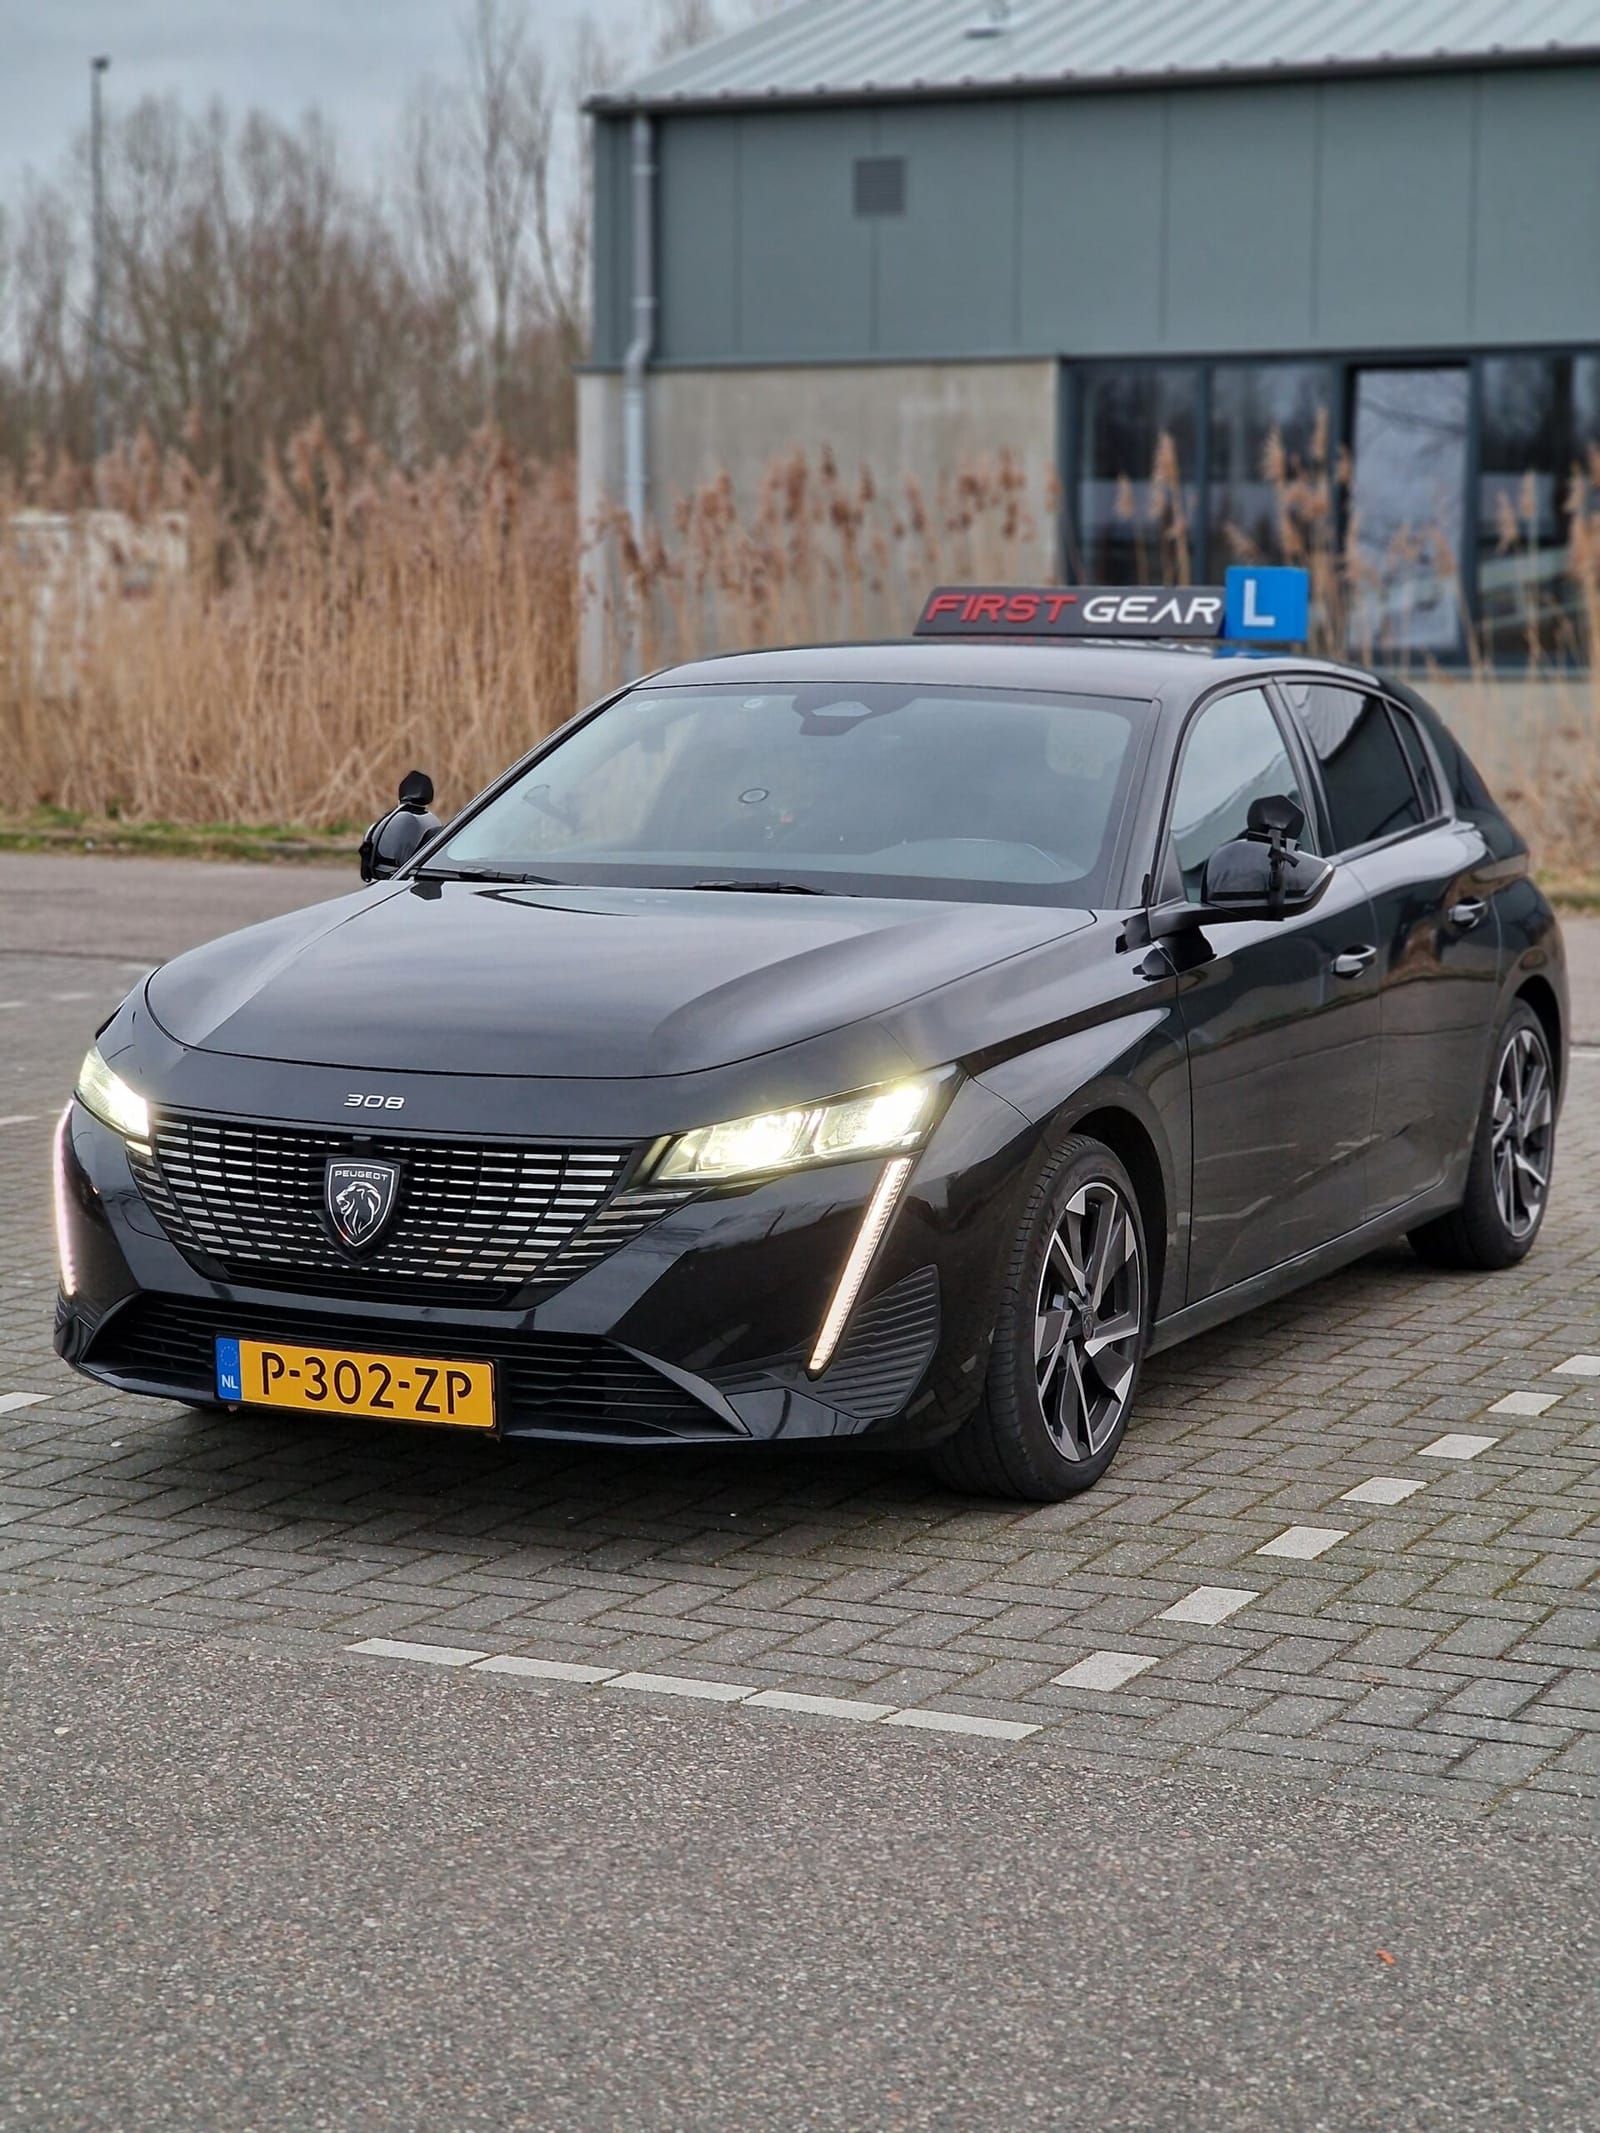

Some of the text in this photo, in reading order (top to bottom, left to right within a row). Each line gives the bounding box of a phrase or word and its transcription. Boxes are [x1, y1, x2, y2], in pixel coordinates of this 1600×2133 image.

[926, 594, 1221, 624] FIRST GEAR
[1243, 579, 1276, 627] L
[344, 1093, 405, 1109] 308
[334, 1169, 388, 1181] PEUGEOT
[221, 1374, 239, 1390] NL
[261, 1351, 472, 1414] P-302-ZP
